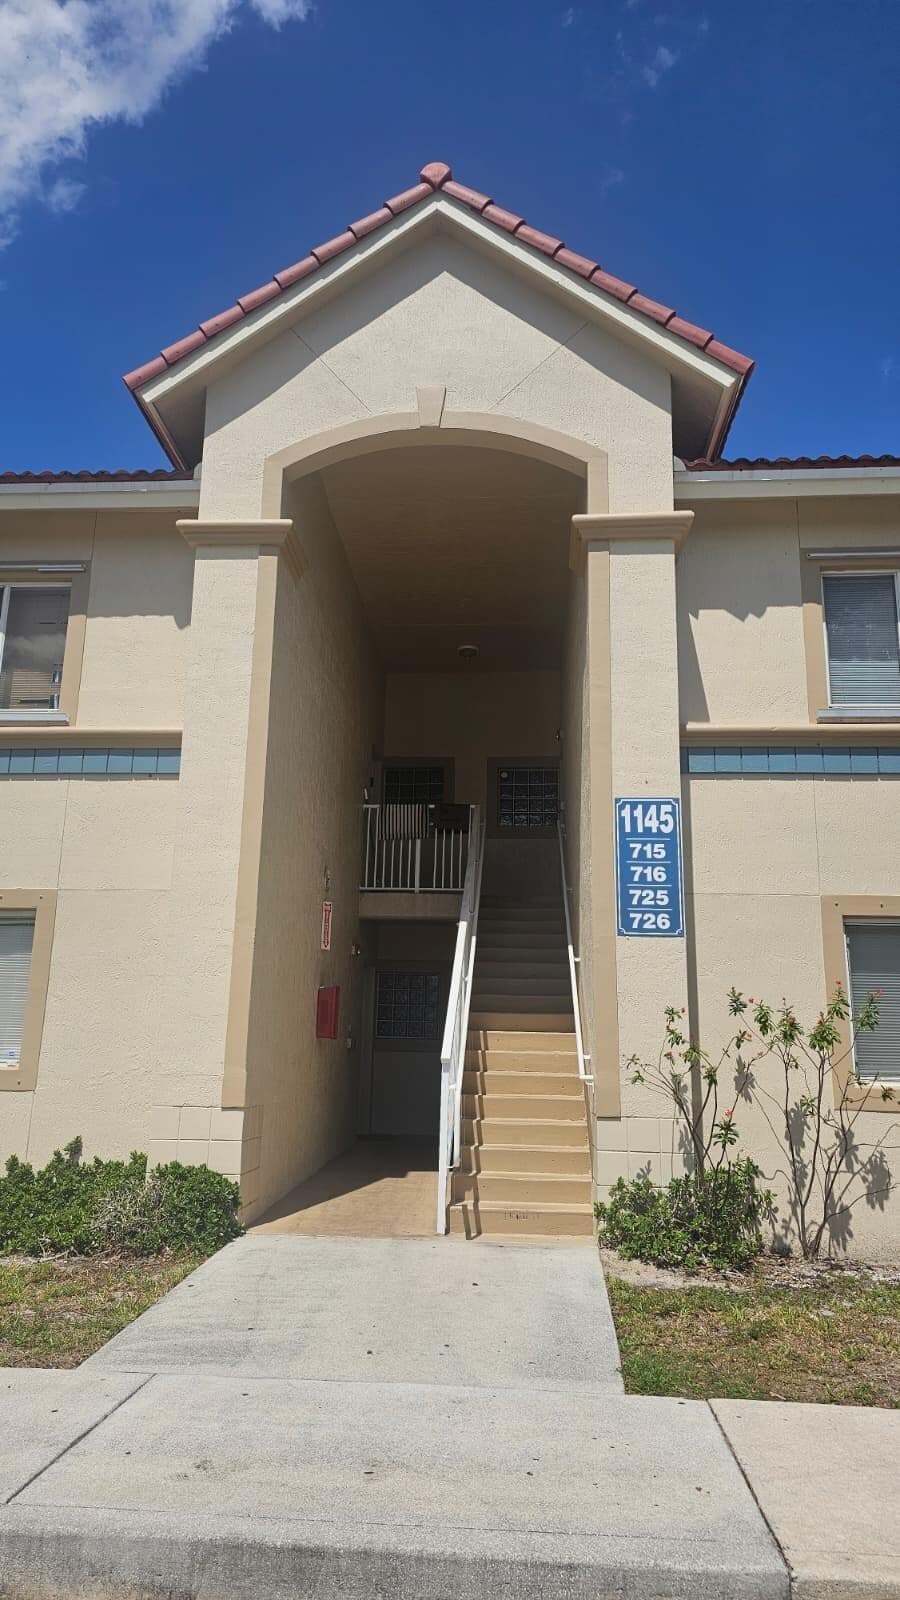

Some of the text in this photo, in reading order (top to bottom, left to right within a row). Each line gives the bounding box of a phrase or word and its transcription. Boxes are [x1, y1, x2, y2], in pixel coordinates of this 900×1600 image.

[621, 804, 674, 834] 1145
[629, 843, 666, 859] 715
[630, 866, 667, 882] 716
[629, 889, 669, 905] 725
[629, 913, 670, 929] 726
